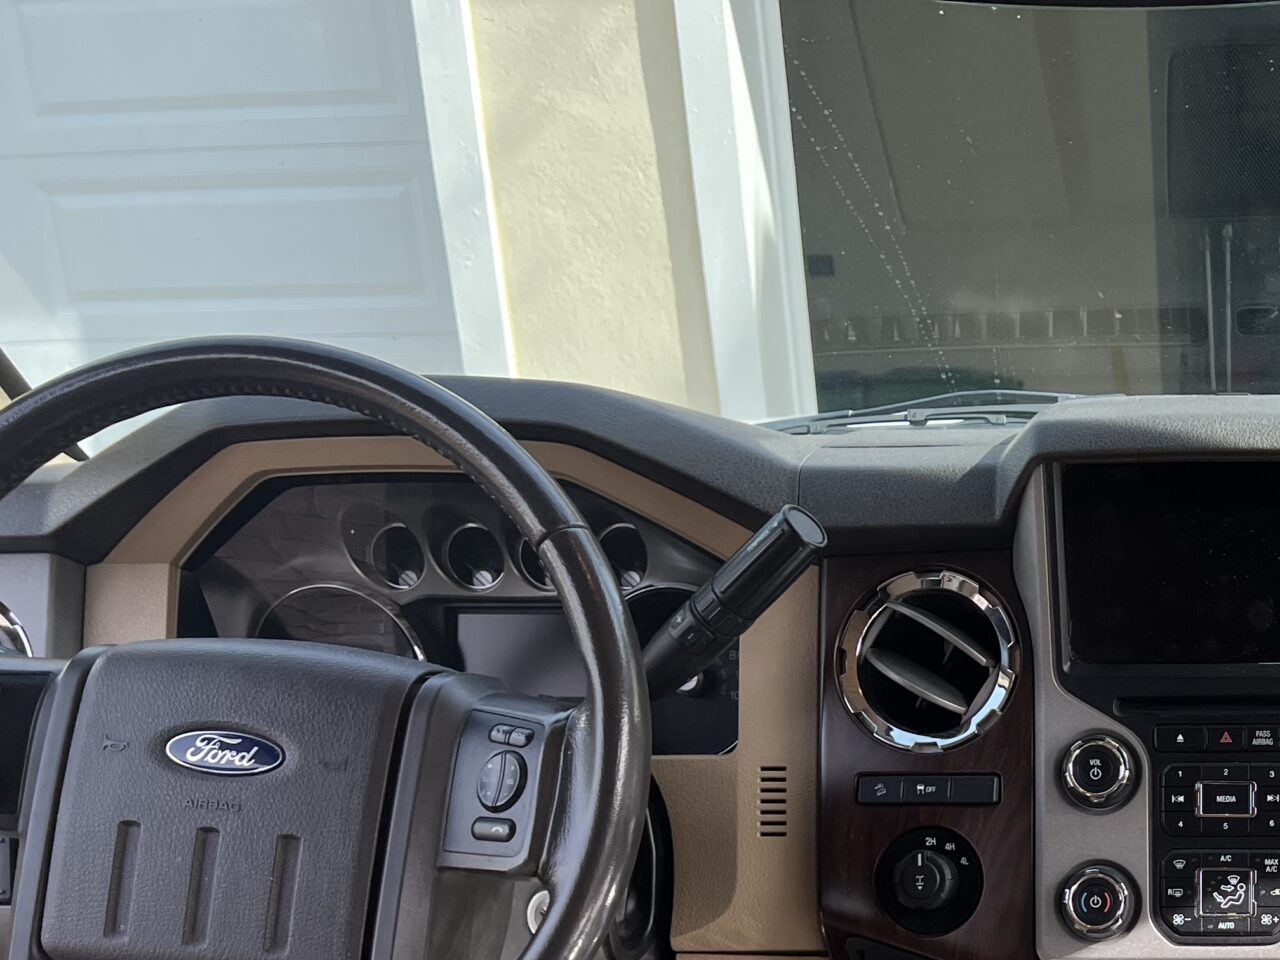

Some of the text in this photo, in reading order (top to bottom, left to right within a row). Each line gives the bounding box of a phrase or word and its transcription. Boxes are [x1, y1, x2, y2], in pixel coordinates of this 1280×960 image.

[1255, 730, 1271, 738] PASS
[1252, 738, 1273, 746] AIRBAG
[186, 735, 259, 767] Ford
[926, 785, 936, 793] OFF
[1216, 795, 1236, 803] MEDIA
[925, 837, 936, 846] 2H
[945, 842, 955, 851] 4H
[960, 856, 970, 865] 4L
[1218, 922, 1235, 930] AUTO
